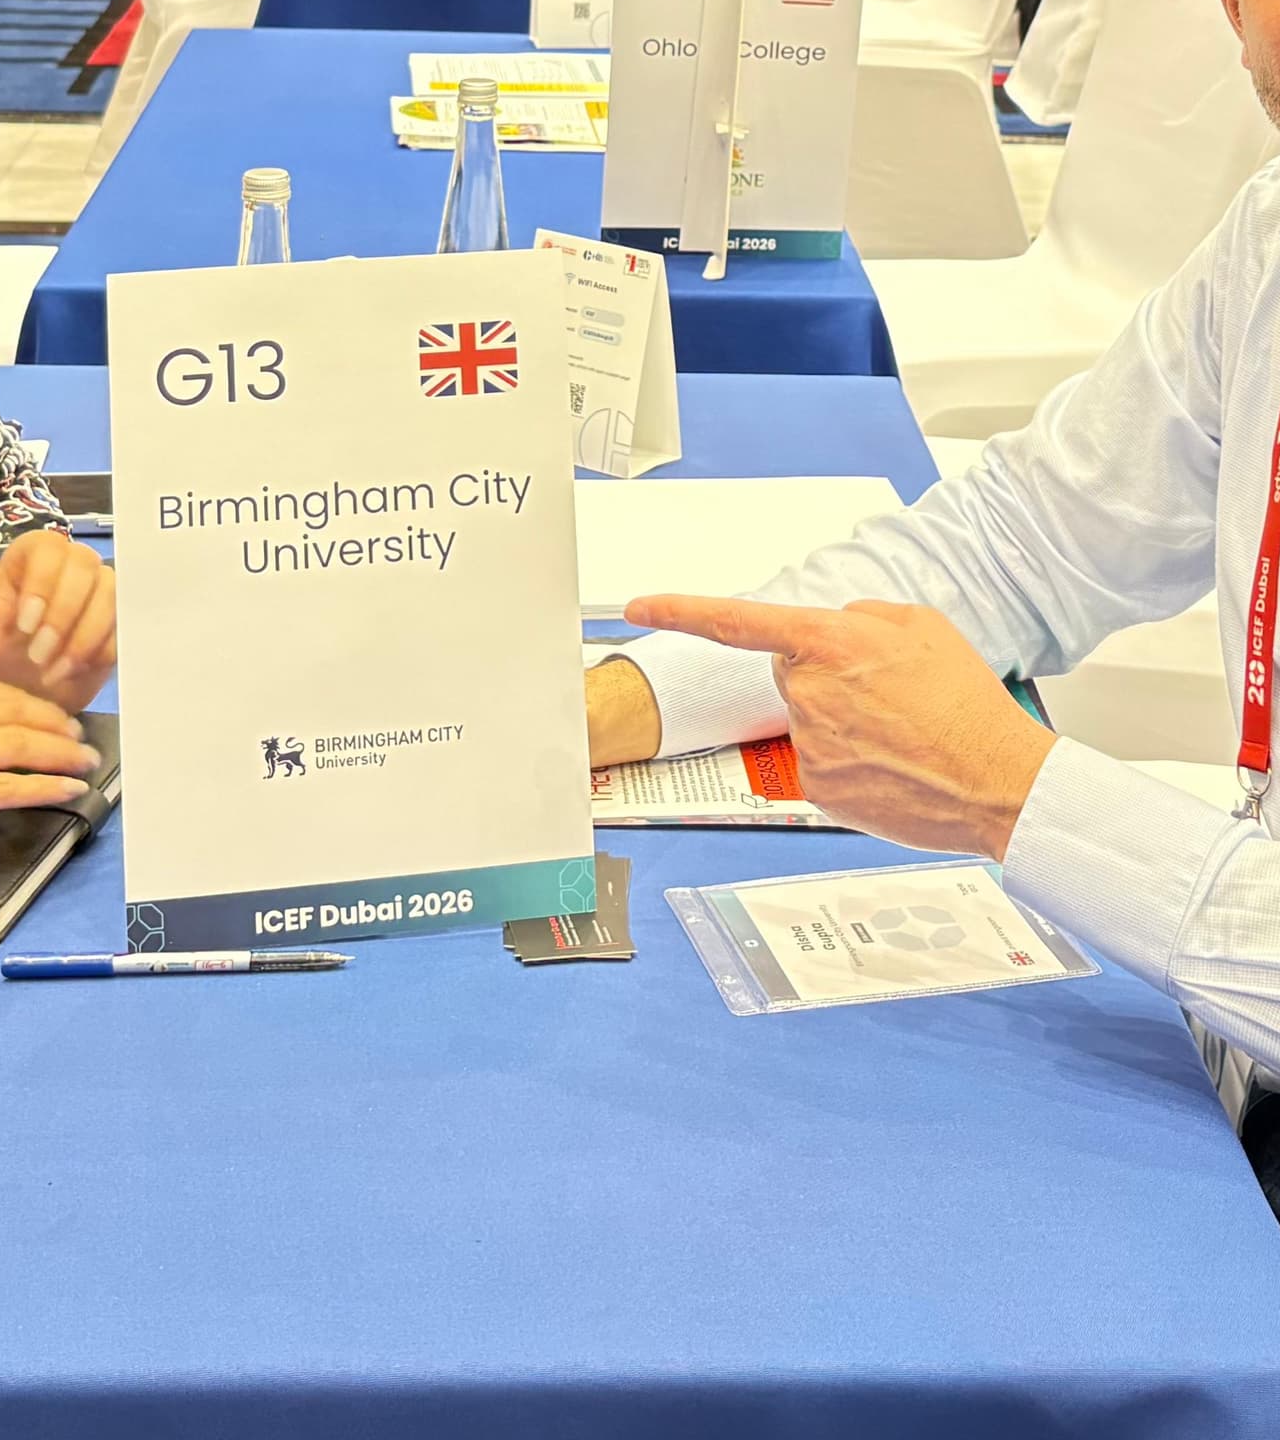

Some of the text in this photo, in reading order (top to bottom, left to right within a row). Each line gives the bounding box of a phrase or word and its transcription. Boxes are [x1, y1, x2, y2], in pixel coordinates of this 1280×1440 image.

[642, 38, 698, 57] Ohlo
[741, 238, 777, 250] 2026
[156, 339, 286, 406] G13
[158, 469, 532, 530] Birmingham City
[242, 525, 457, 574] University
[1254, 557, 1271, 613] Dubai
[1252, 616, 1265, 657] ICEF
[314, 724, 465, 754] BIRMINGHAM CITY
[315, 751, 387, 769] University
[254, 889, 474, 935] ICEF Dubai 2026
[790, 925, 815, 952] Disha
[811, 922, 836, 951] Gupta
